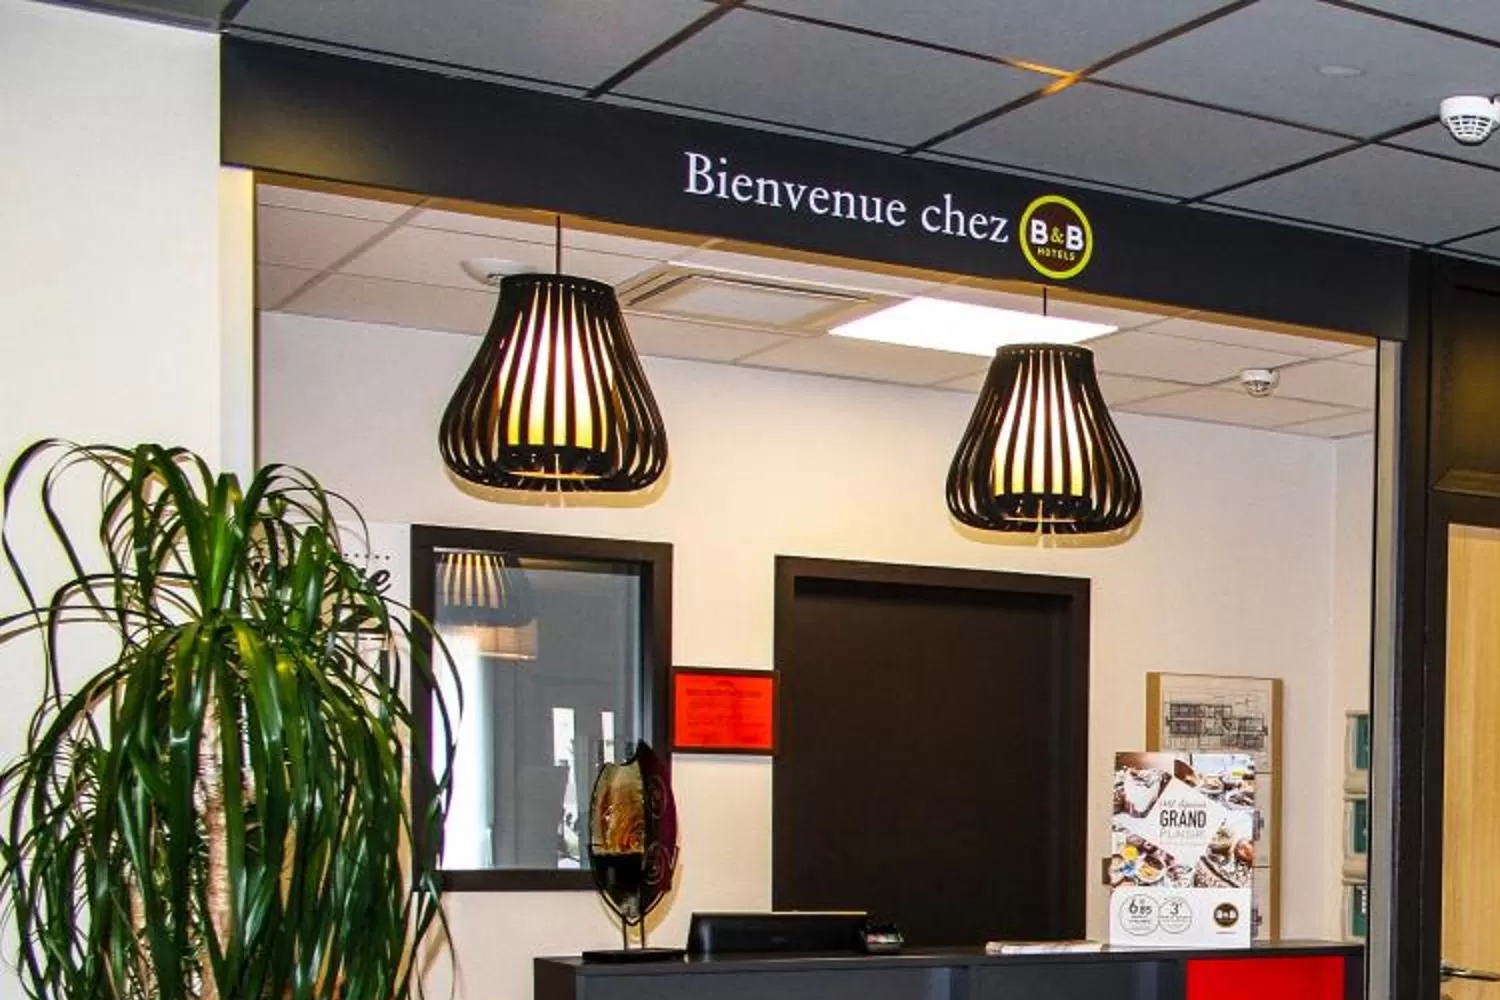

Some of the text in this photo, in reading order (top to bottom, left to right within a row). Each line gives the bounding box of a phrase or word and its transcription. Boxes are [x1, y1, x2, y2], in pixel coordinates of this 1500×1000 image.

[684, 151, 1009, 243] Bienvenue chez
[1031, 219, 1084, 251] B&B
[1037, 247, 1076, 261] HOTELS
[1160, 809, 1207, 829] GRAND
